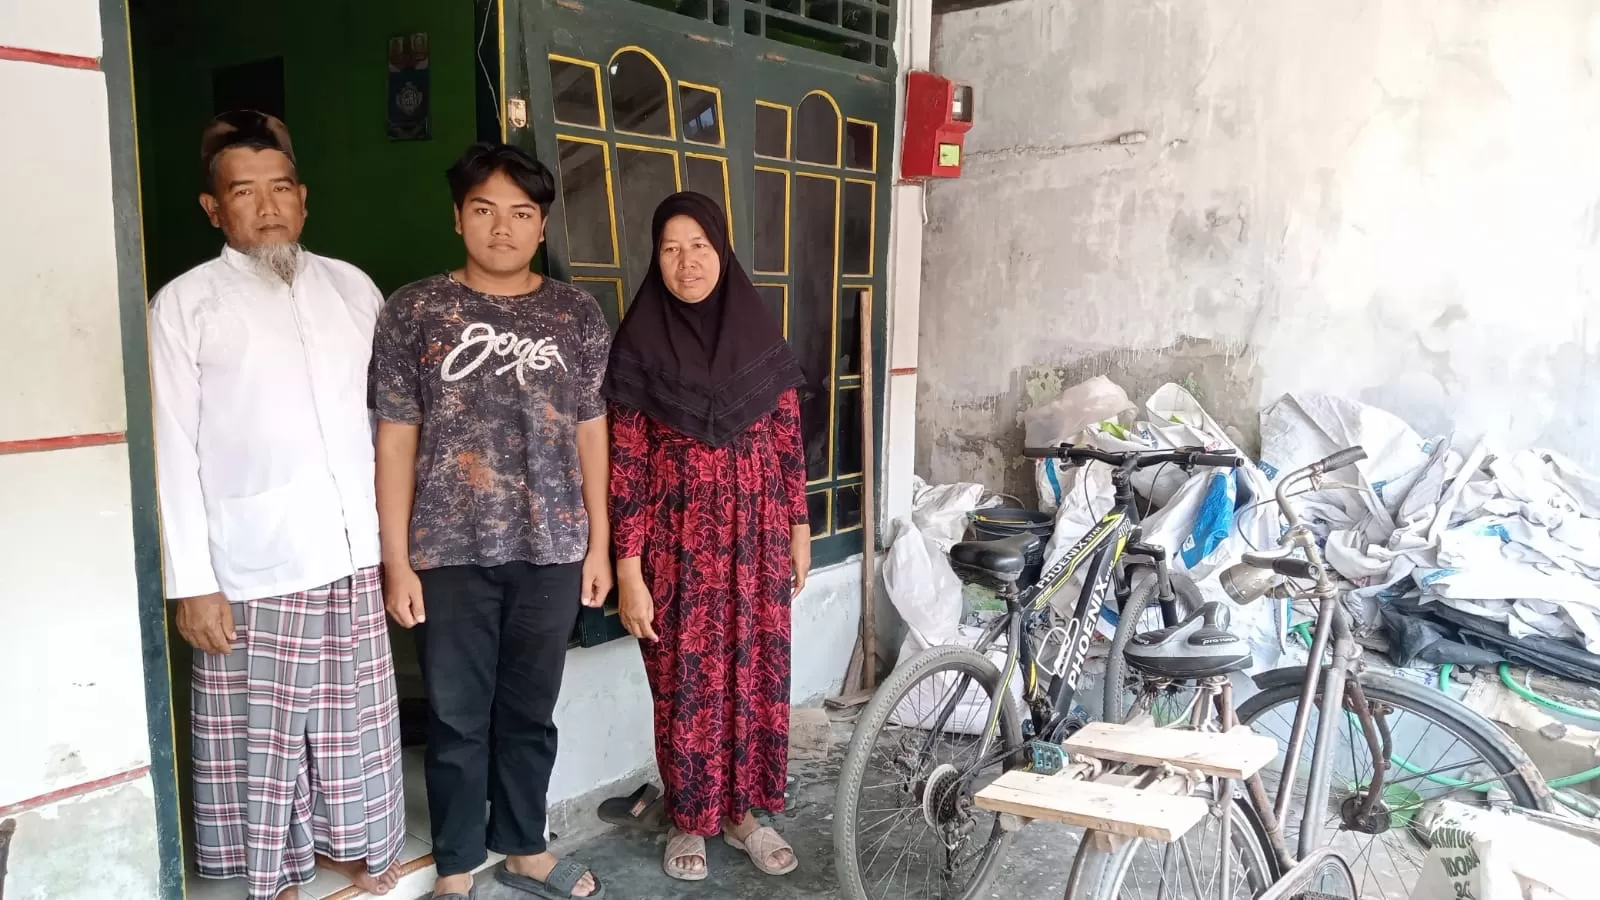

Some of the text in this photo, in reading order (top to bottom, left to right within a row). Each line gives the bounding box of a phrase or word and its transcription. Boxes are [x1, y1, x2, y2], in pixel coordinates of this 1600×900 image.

[1036, 526, 1102, 589] PHOENIX STAR
[1068, 575, 1108, 690] PHOENIX
